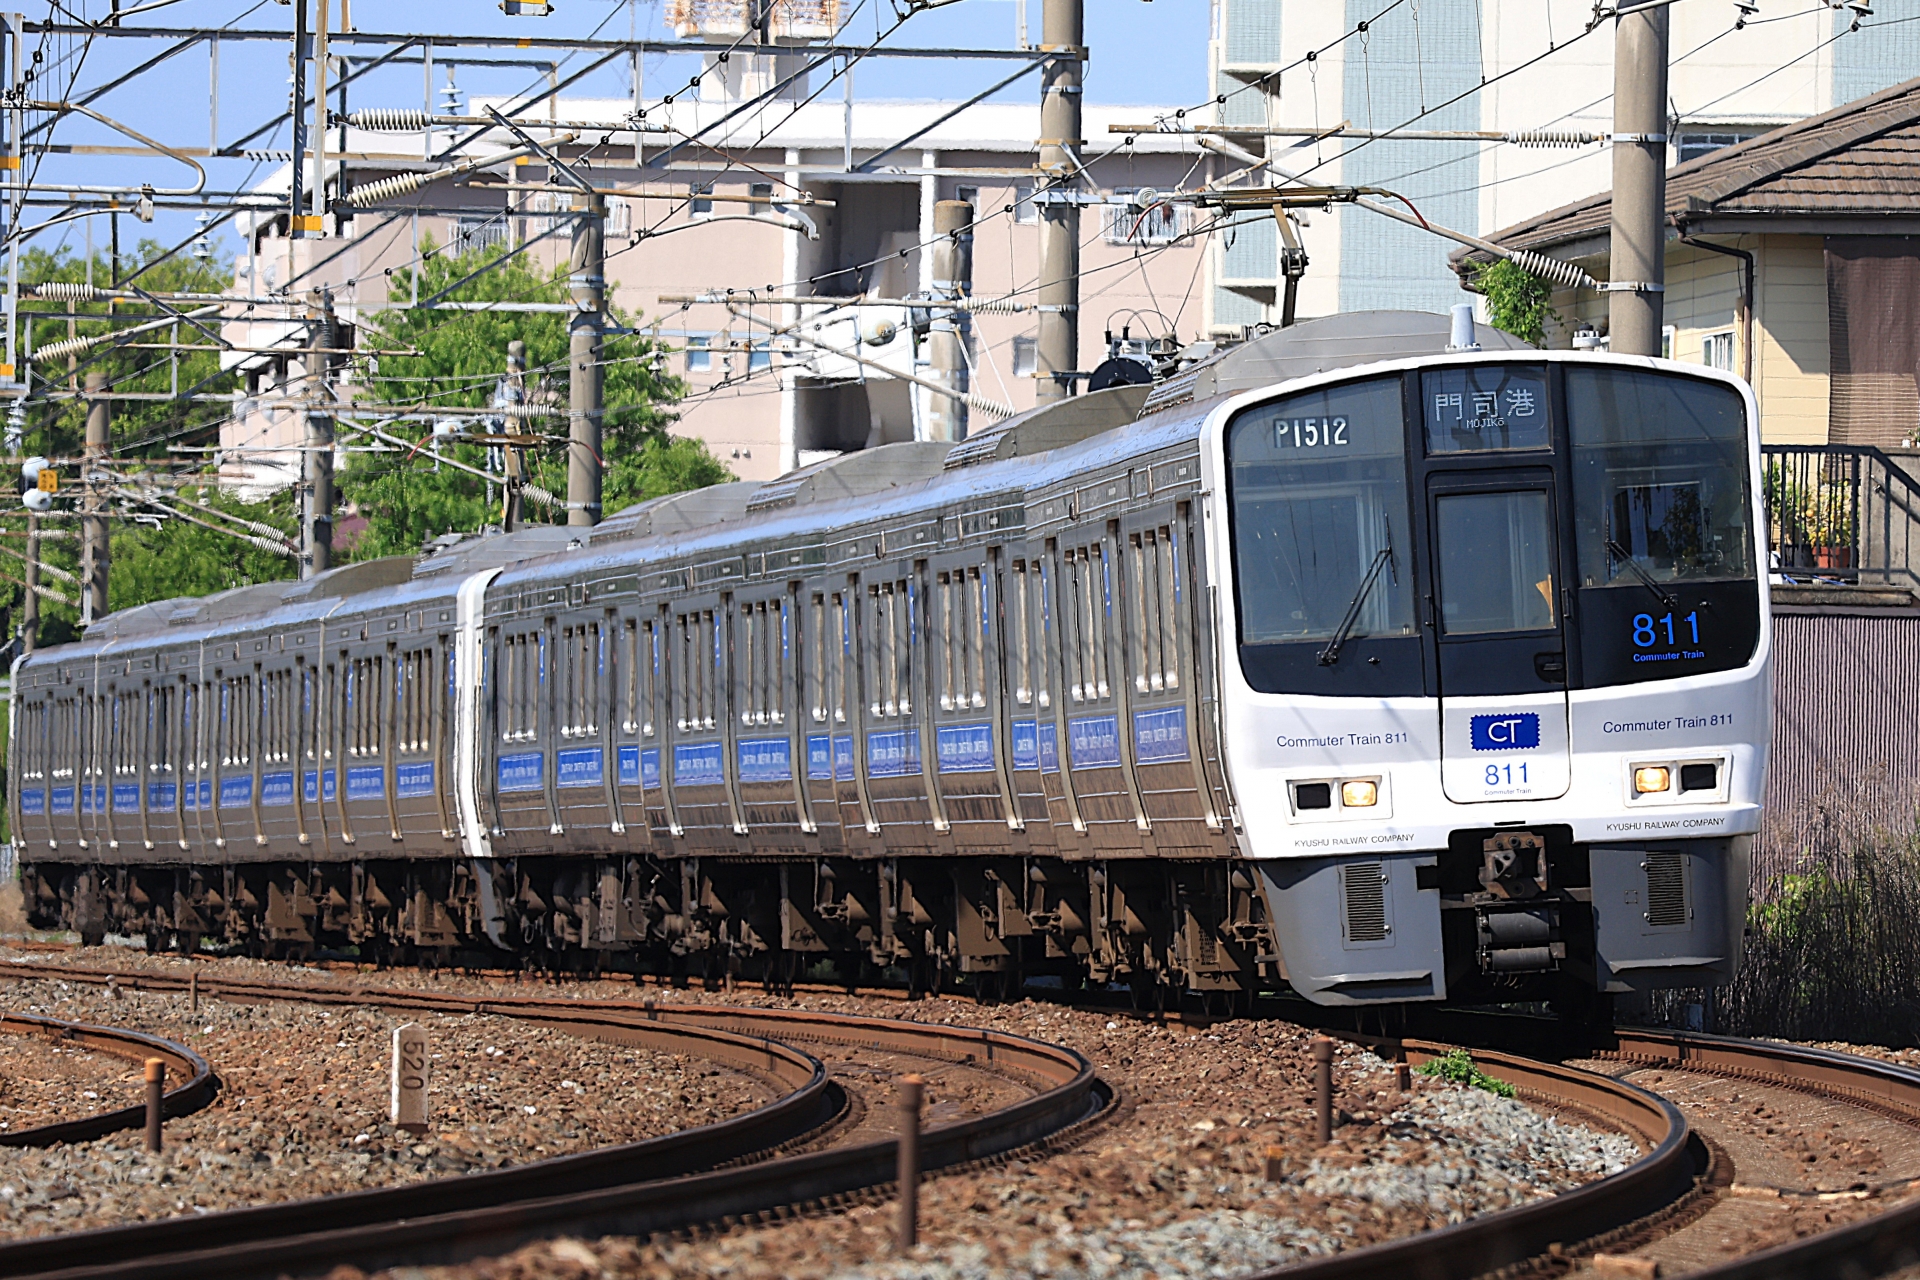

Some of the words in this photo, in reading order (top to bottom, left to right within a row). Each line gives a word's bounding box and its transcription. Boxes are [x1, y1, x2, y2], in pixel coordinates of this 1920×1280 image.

[1435, 389, 1535, 421] 門司港
[1275, 417, 1348, 448] P1512
[1633, 611, 1699, 647] 811
[1633, 652, 1681, 663] Commuter
[1682, 650, 1705, 660] Train
[1488, 719, 1522, 743] CT
[1603, 719, 1672, 733] Commuter
[1674, 716, 1707, 728] Train
[1710, 713, 1732, 726] 811
[1276, 735, 1345, 747] Commuter
[1347, 733, 1381, 745] Train
[1385, 732, 1408, 744] 811
[1485, 762, 1527, 785] 811
[1606, 822, 1641, 831] KYUSHU
[1644, 820, 1680, 829] RAILWAY
[1683, 818, 1725, 827] COMPANY
[1294, 838, 1330, 847] KYUSHU
[1332, 836, 1368, 846] RAILWAY
[1371, 833, 1415, 844] COMPANY
[402, 1041, 425, 1090] 520
